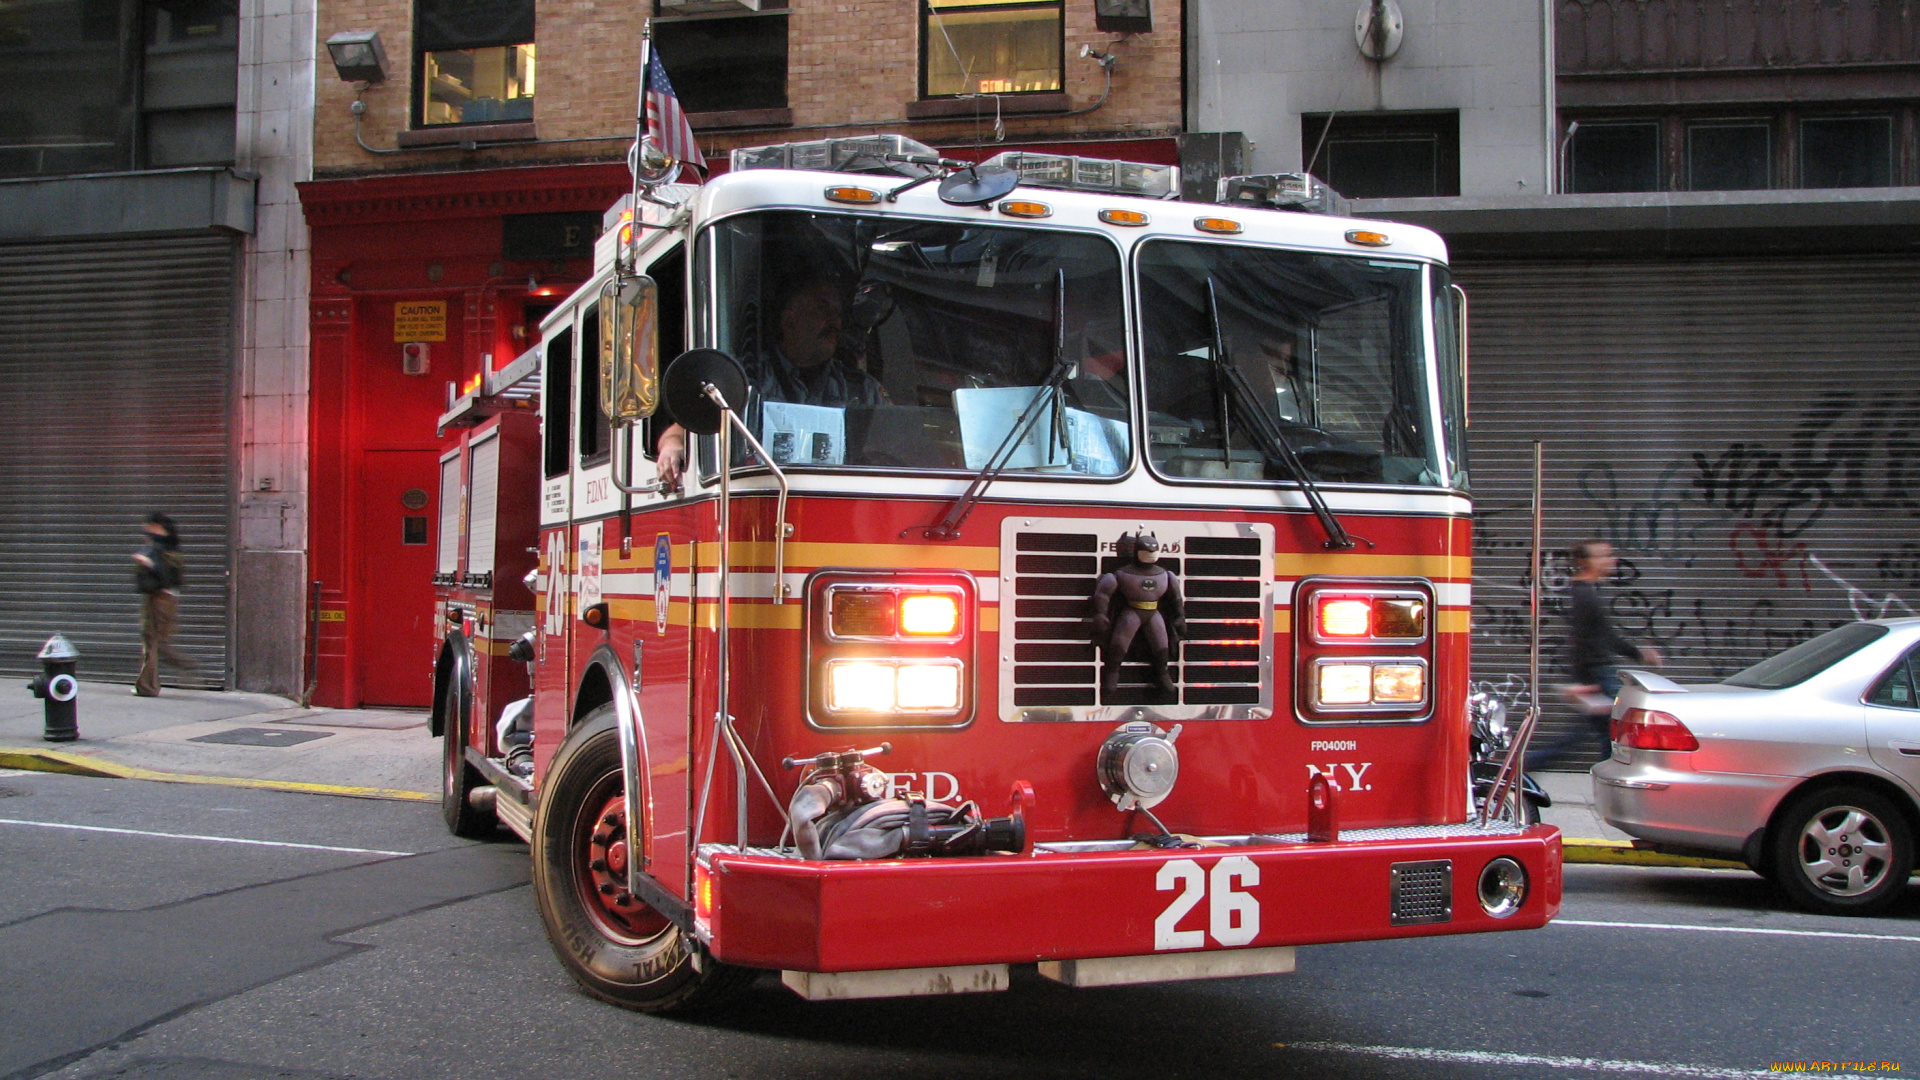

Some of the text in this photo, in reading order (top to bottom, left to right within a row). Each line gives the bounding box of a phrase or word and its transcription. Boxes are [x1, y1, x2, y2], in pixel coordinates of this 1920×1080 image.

[401, 305, 440, 315] CAUTION
[546, 531, 565, 636] 26
[1311, 740, 1356, 751] FP04001H
[1154, 856, 1260, 951] 26
